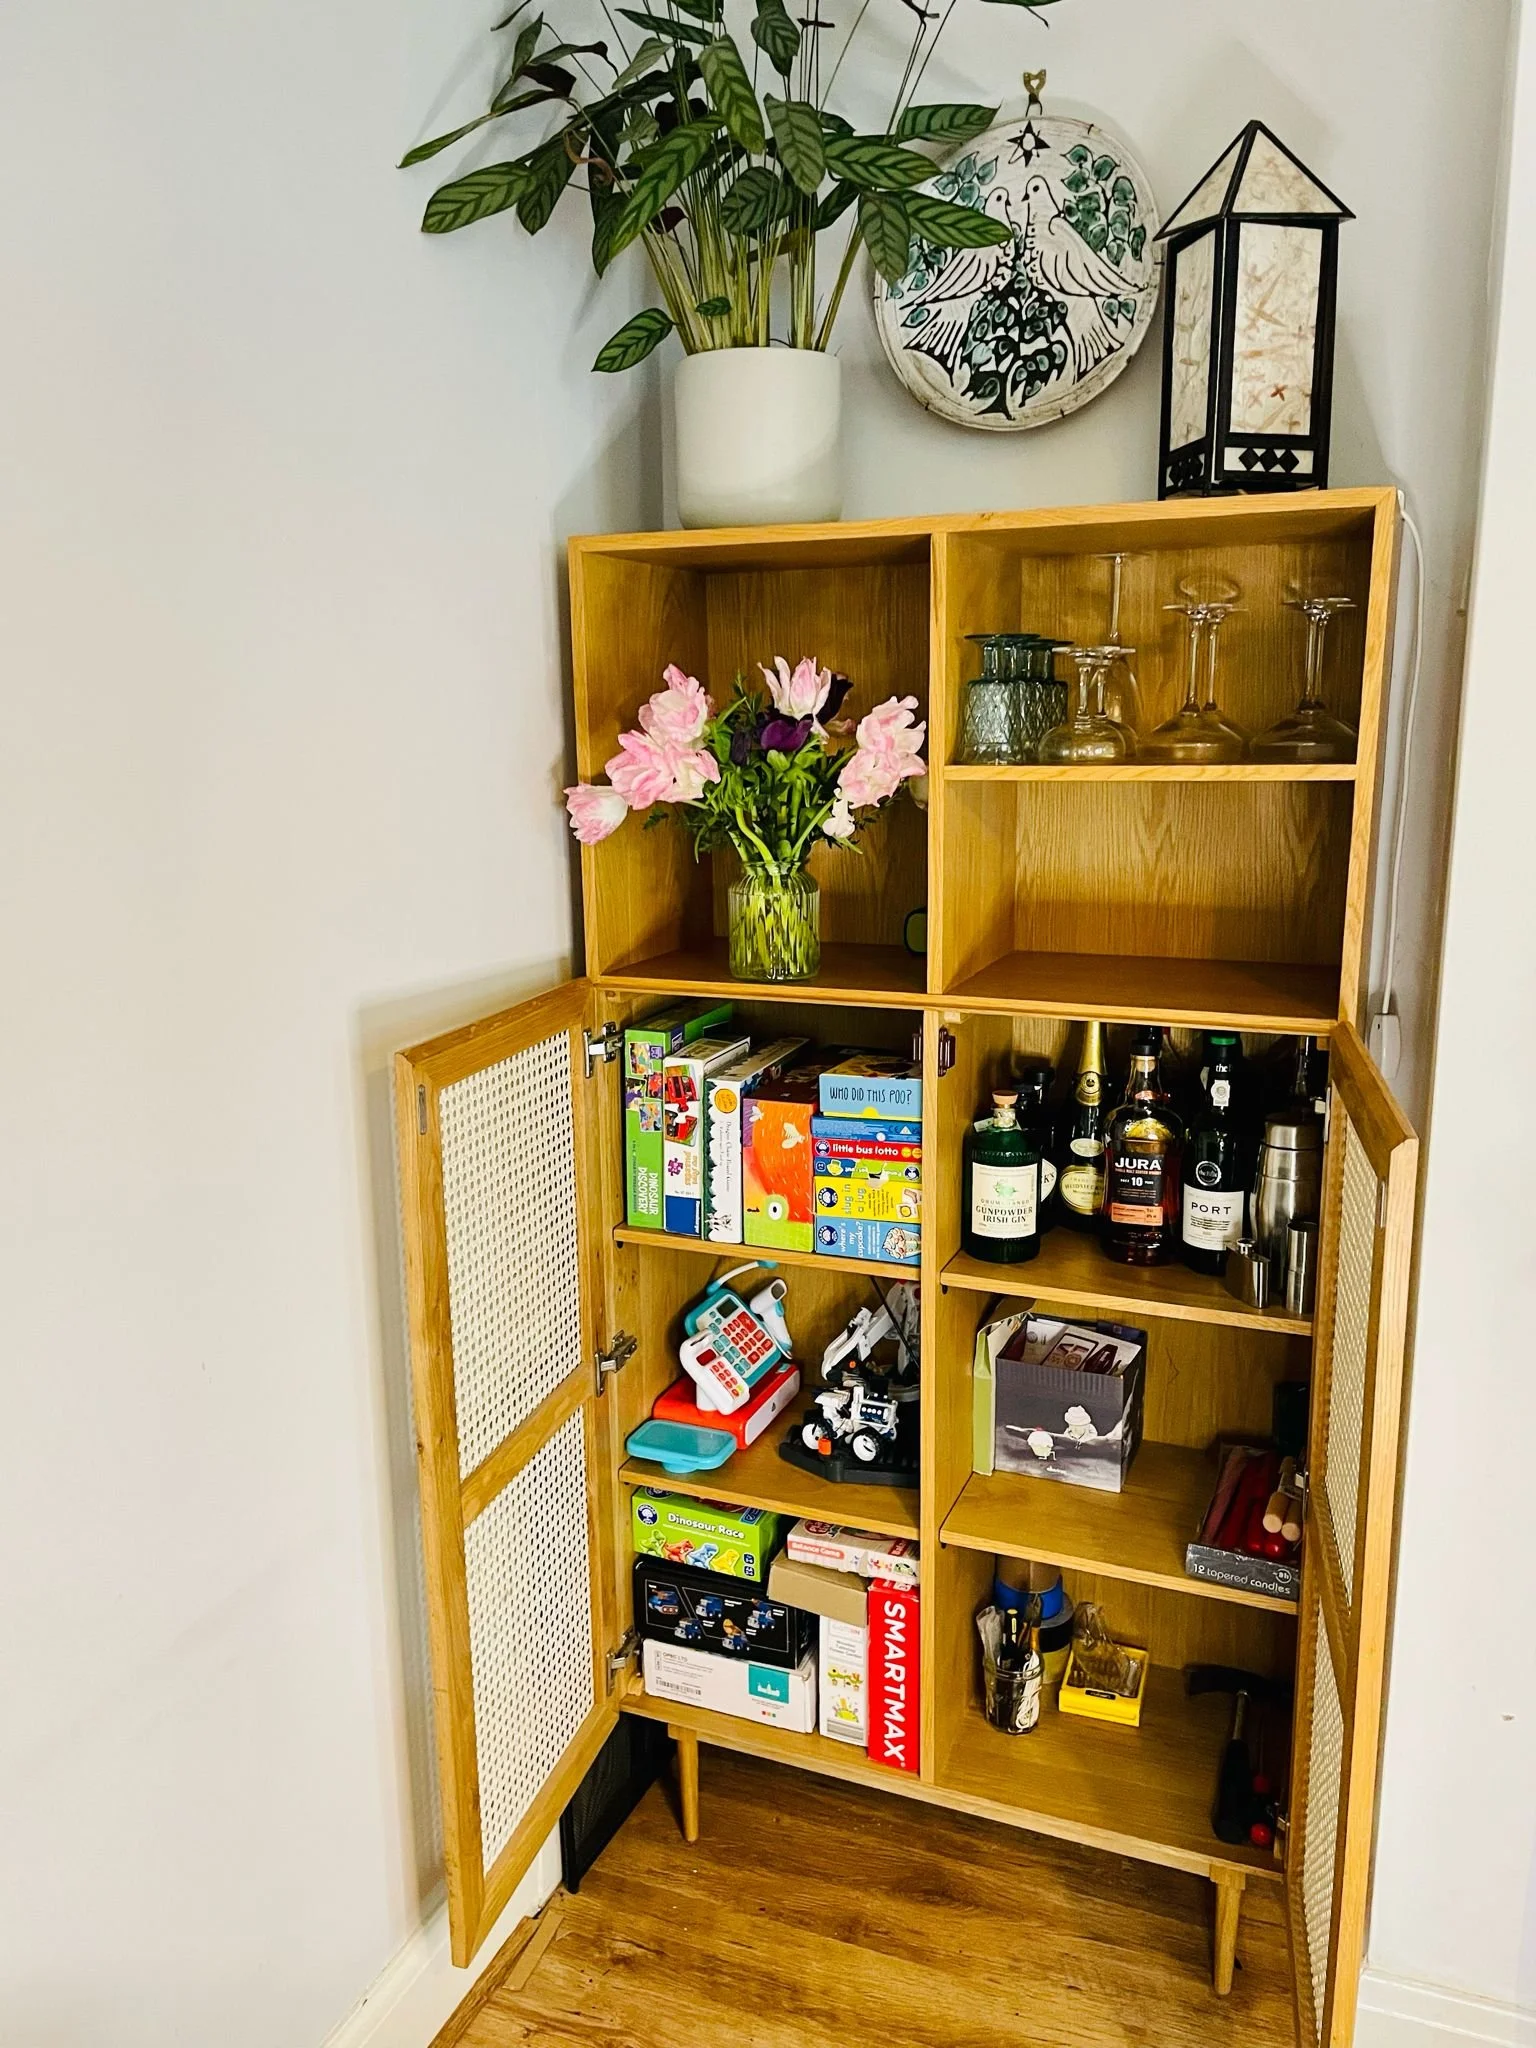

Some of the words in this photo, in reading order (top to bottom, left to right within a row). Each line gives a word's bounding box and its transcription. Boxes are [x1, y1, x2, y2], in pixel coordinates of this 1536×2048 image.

[829, 1087, 849, 1100] WHO
[851, 1088, 864, 1101] DID
[867, 1089, 886, 1103] THIS
[889, 1089, 913, 1105] POO?
[832, 1143, 854, 1153] little
[855, 1144, 873, 1155] bus
[874, 1145, 899, 1156] lotto
[1114, 1157, 1161, 1171] JURA
[637, 1166, 648, 1215] DISCOVERY
[842, 1183, 851, 1192] in
[1131, 1177, 1143, 1187] 10
[648, 1172, 659, 1216] DINOSAUR
[855, 1188, 866, 1204] jug
[841, 1196, 853, 1214] slug
[975, 1205, 1033, 1216] GUNPOWDER
[1191, 1201, 1232, 1215] PORT
[983, 1214, 1008, 1224] IRISH
[838, 1222, 847, 1253] where's
[849, 1232, 857, 1245] my
[855, 1221, 865, 1257] cupcake?
[667, 1512, 716, 1533] Dinosaur
[718, 1525, 745, 1539] Race
[1193, 1563, 1206, 1575] 12
[1206, 1568, 1249, 1585] tapered
[1250, 1578, 1291, 1595] candles
[883, 1600, 906, 1763] SMARTMAX
